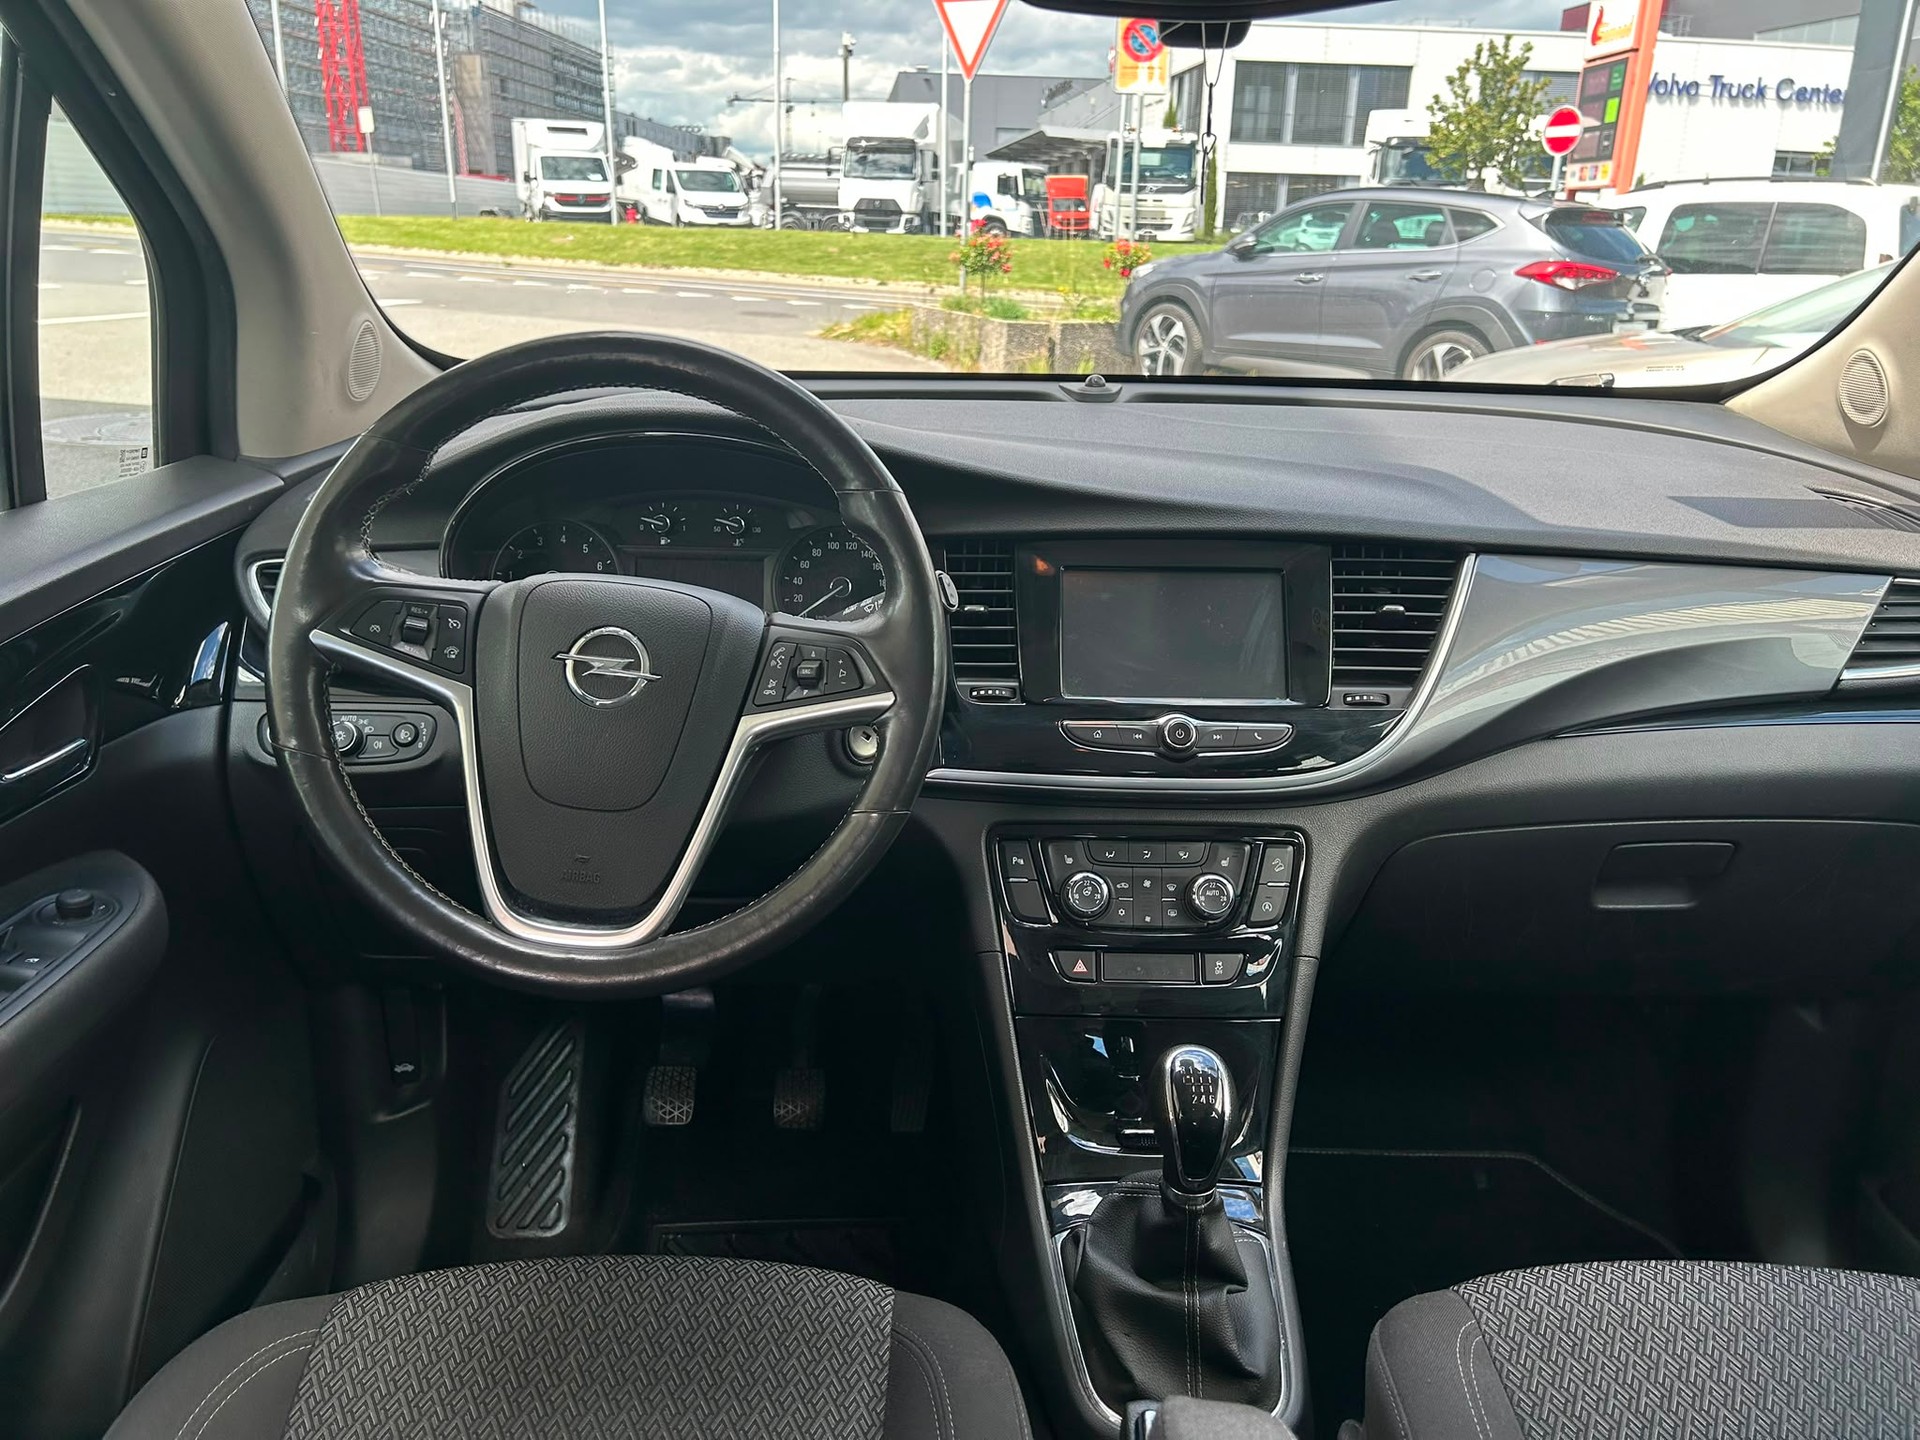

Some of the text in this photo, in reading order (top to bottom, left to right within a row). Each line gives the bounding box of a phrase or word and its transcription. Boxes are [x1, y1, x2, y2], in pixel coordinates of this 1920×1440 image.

[1708, 75, 1767, 100] Truck
[537, 537, 543, 546] 3
[560, 535, 566, 544] 4
[582, 544, 588, 553] 5
[845, 542, 857, 550] 120
[517, 550, 523, 559] 2
[861, 550, 873, 558] 140
[597, 562, 603, 570] 6
[800, 560, 809, 568] 60
[793, 577, 802, 585] 40
[793, 594, 803, 602] 20
[1192, 1094, 1216, 1104] 2 4 6
